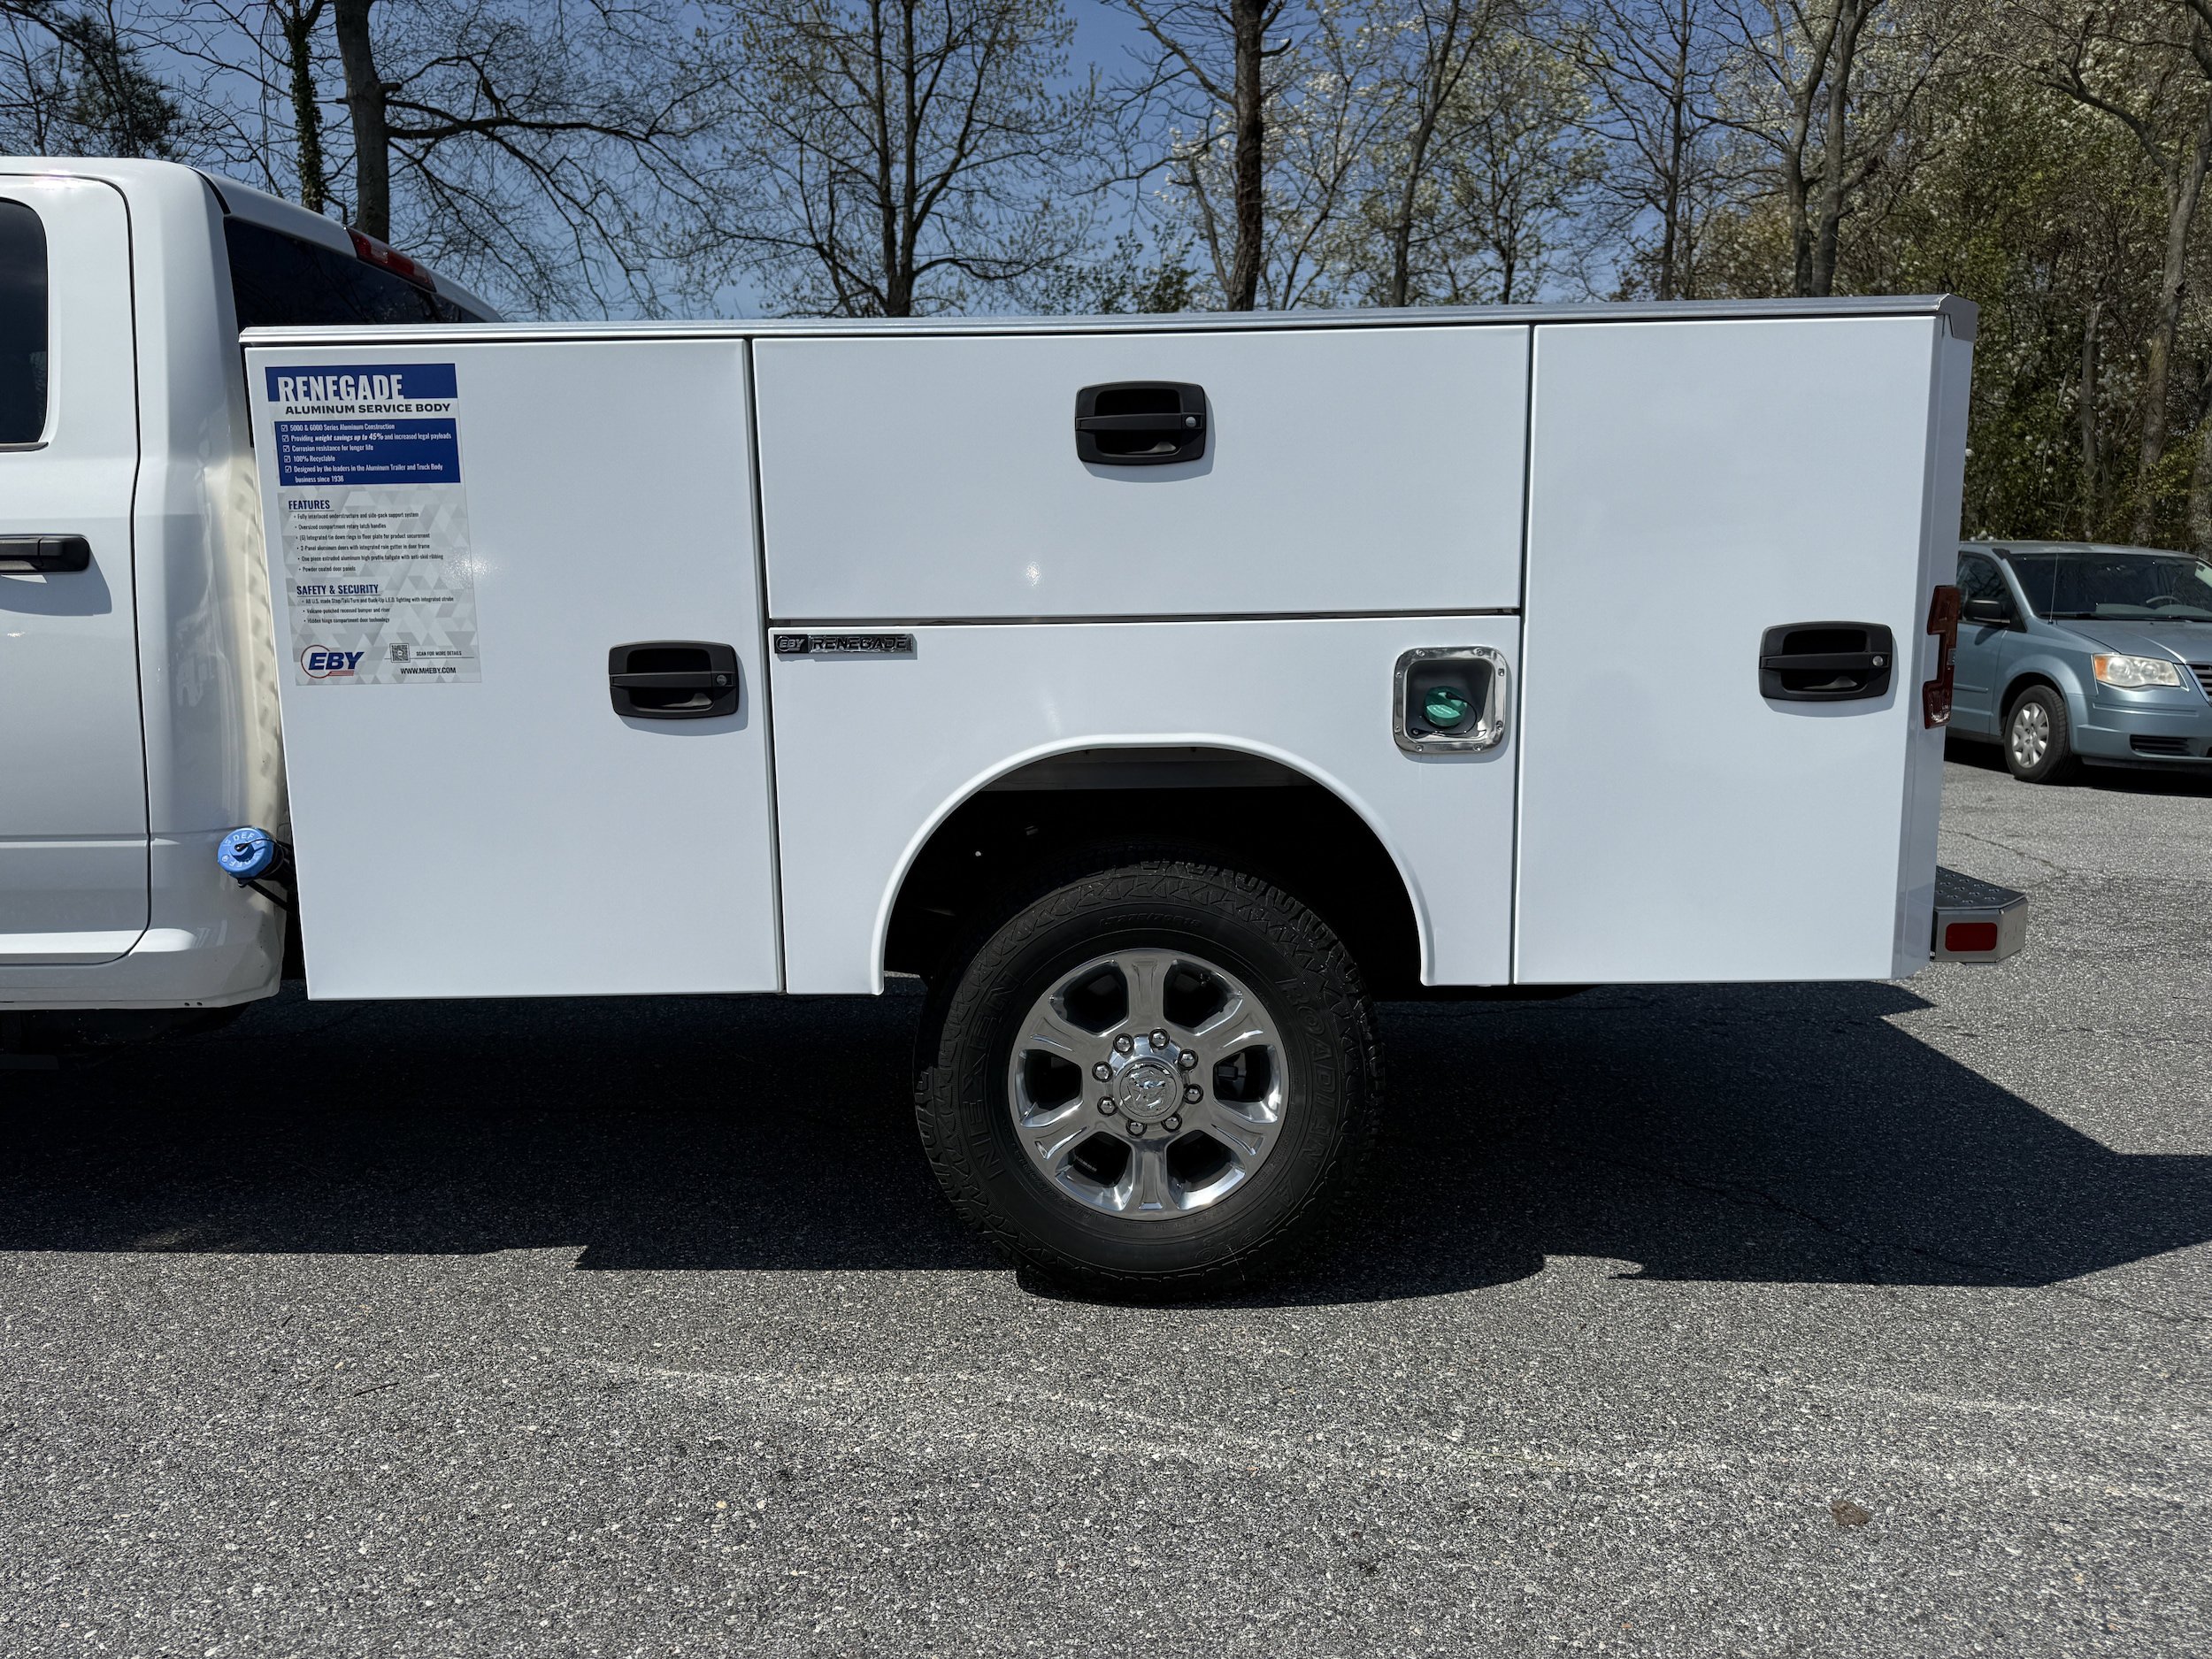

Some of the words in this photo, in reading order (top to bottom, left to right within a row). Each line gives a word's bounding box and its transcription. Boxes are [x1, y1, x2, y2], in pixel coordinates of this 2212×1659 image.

[277, 374, 404, 402] RENEGADE
[286, 405, 355, 414] ALUMINUM
[358, 404, 412, 413] SERVICE
[416, 403, 450, 412] BODY
[288, 500, 330, 510] FEATURES
[297, 585, 326, 595] SAFETY
[330, 585, 335, 594] &
[338, 584, 378, 594] SECURITY
[779, 639, 805, 648] EBY
[812, 637, 907, 649] RENEGADE
[309, 651, 365, 670] EBY
[966, 973, 1021, 1181] NEXEN
